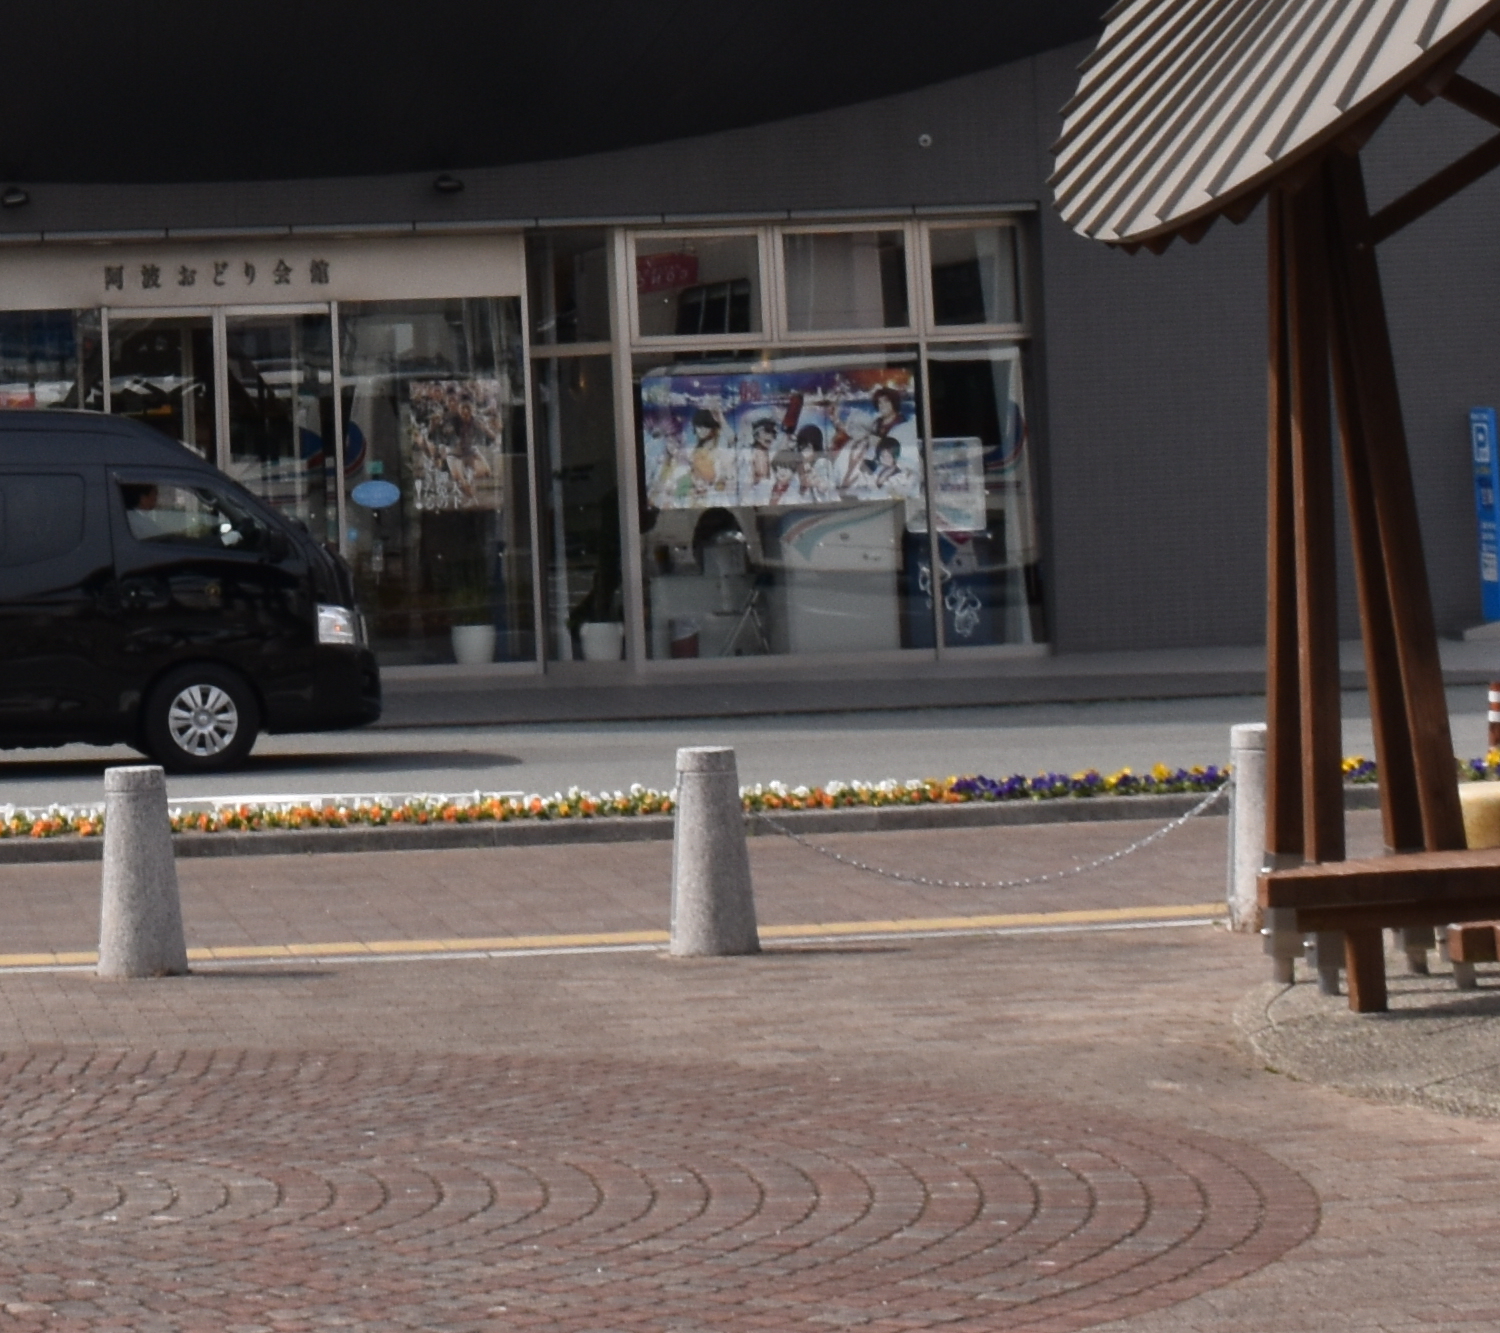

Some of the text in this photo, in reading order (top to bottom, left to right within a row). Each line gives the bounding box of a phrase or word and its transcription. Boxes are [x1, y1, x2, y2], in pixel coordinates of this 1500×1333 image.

[104, 259, 330, 291] 阿波おどり会館
